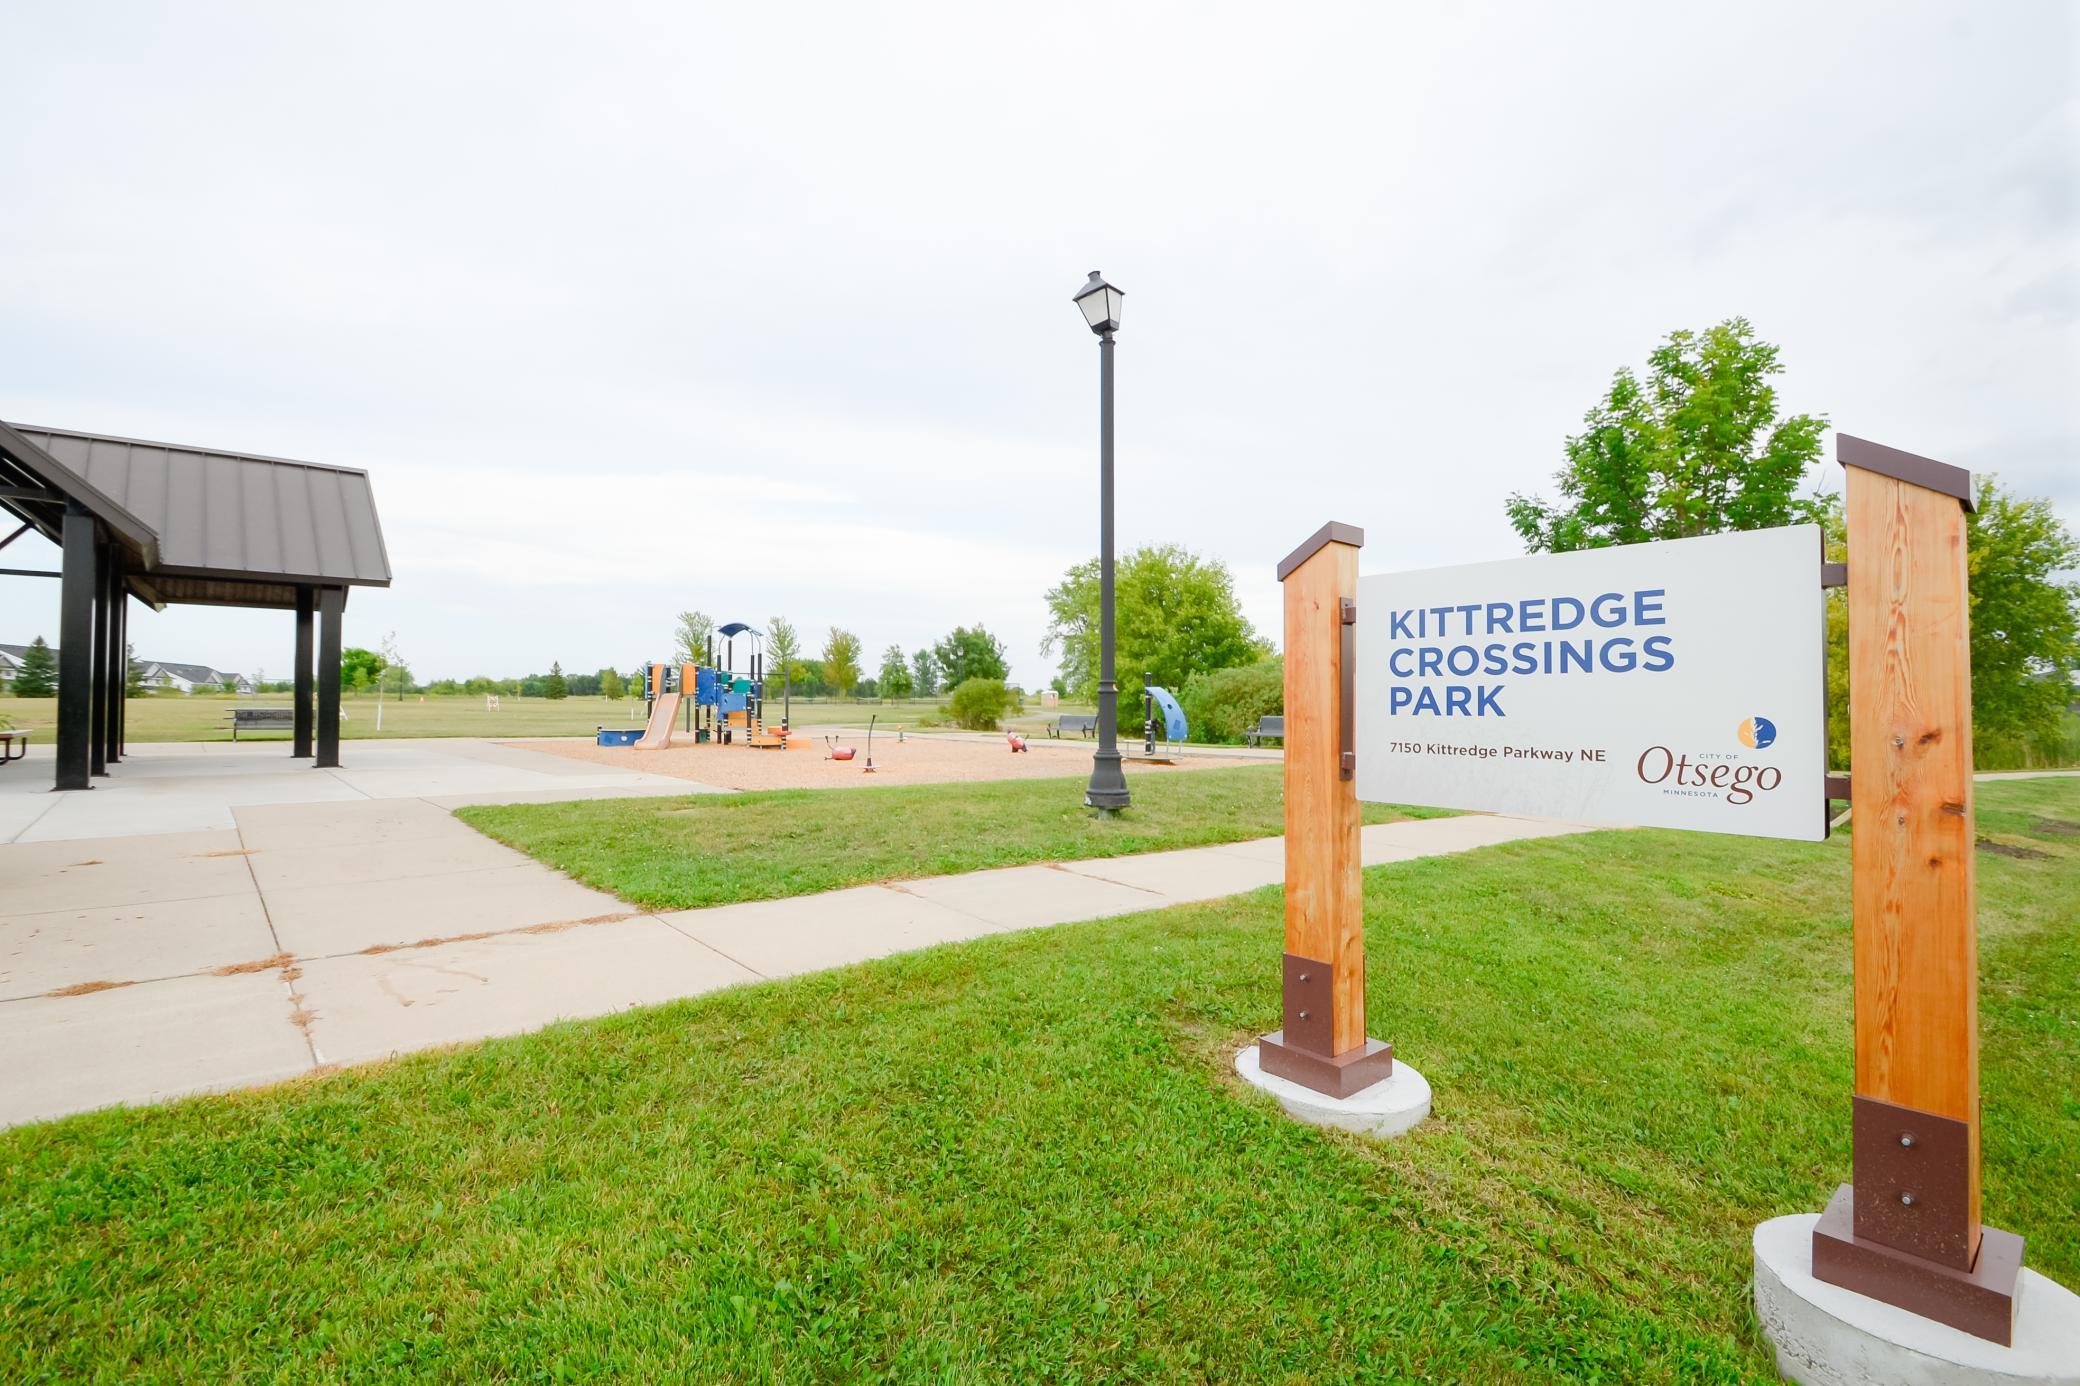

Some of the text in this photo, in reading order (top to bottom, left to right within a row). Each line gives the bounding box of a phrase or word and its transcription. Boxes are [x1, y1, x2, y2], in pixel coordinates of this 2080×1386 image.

[1390, 589, 1666, 640] KITTREDGE
[1389, 636, 1675, 678] CROSSINGS
[1390, 685, 1507, 717] PARK
[1390, 742, 1607, 763] 7150 Kittredge Parkway NE
[1637, 745, 1782, 805] Otsego
[1663, 789, 1719, 798] MINNESOTA
